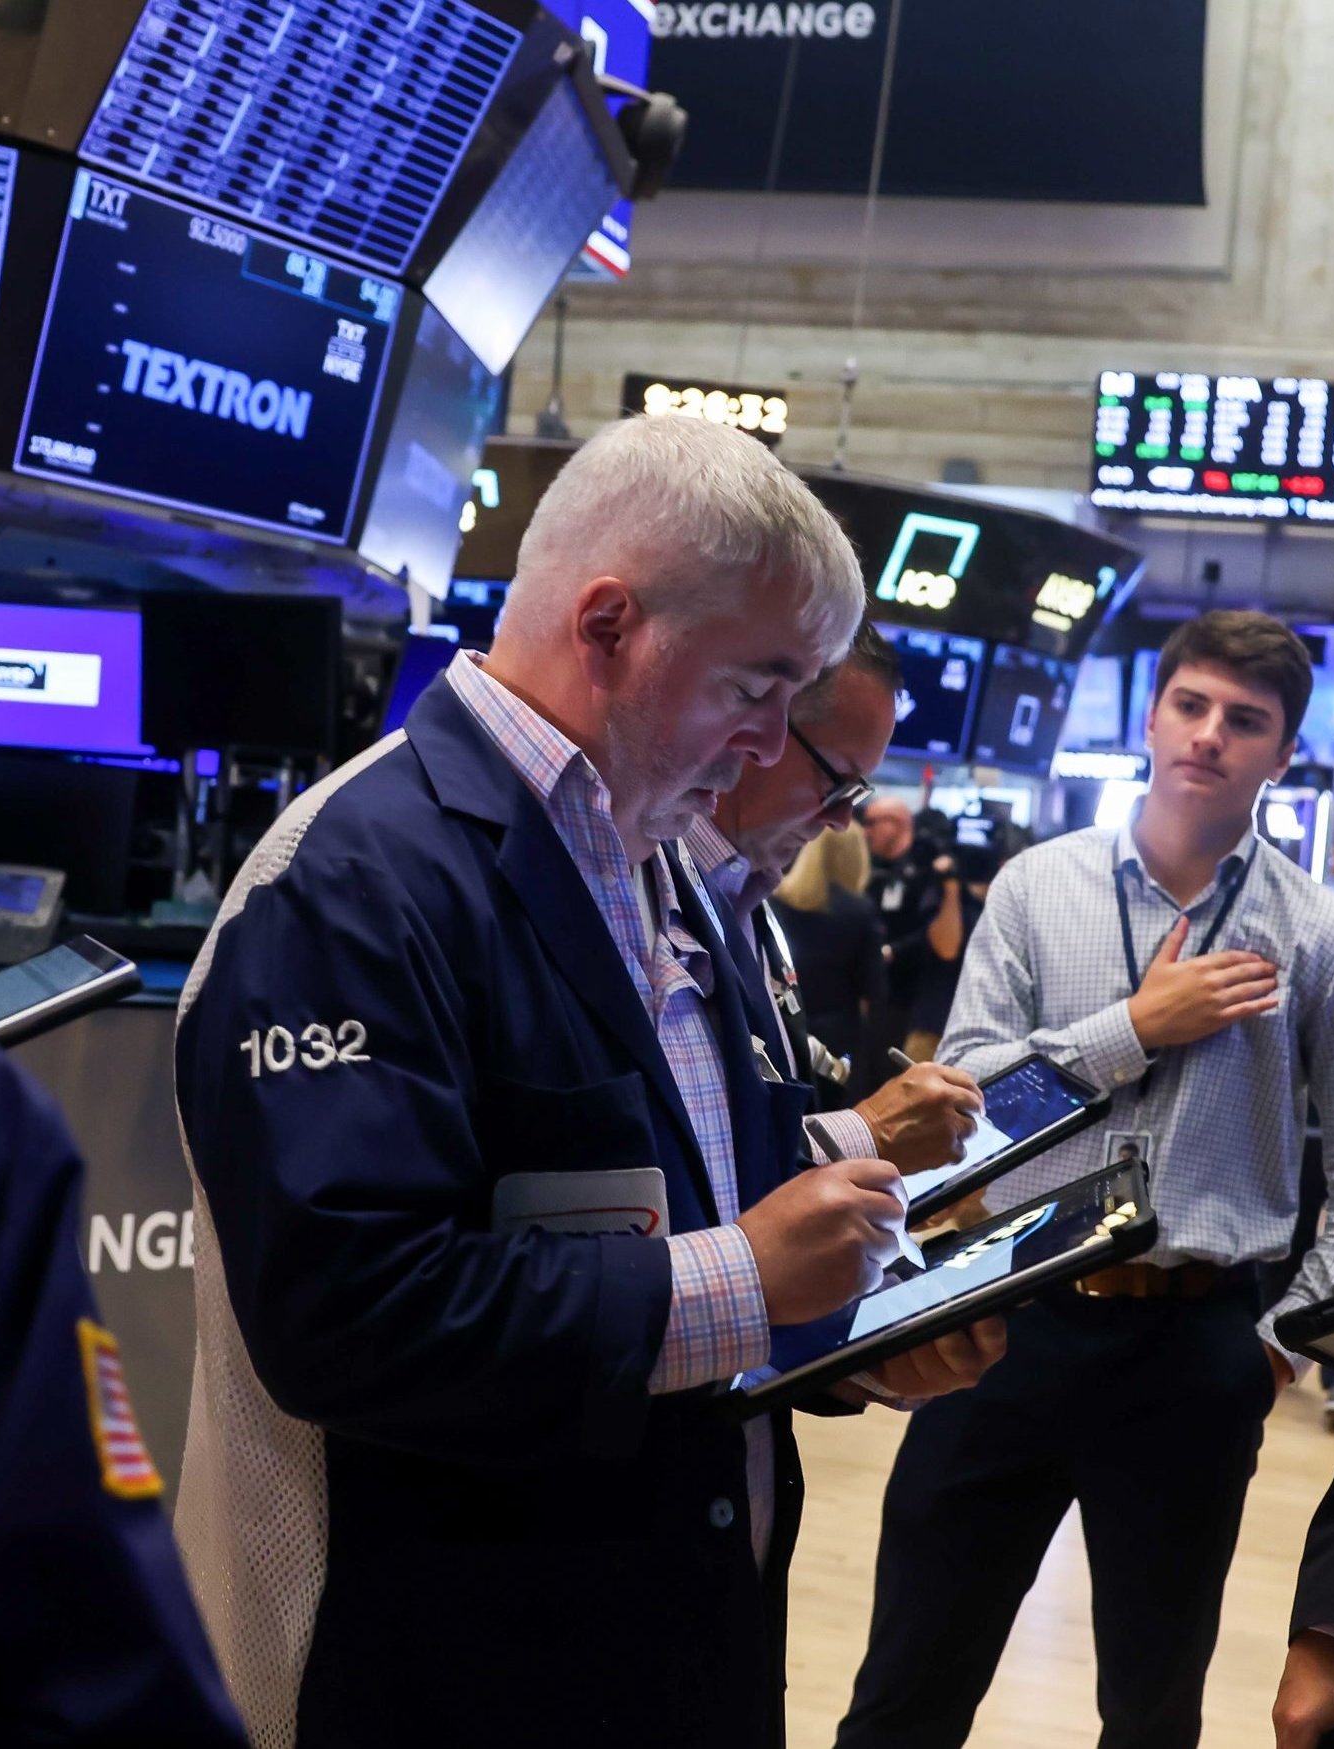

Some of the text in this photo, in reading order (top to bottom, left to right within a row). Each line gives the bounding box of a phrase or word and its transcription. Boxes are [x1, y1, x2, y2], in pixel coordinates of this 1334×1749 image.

[90, 180, 130, 217] TXT
[122, 339, 312, 440] TEXTRON
[240, 1019, 371, 1078] 1032
